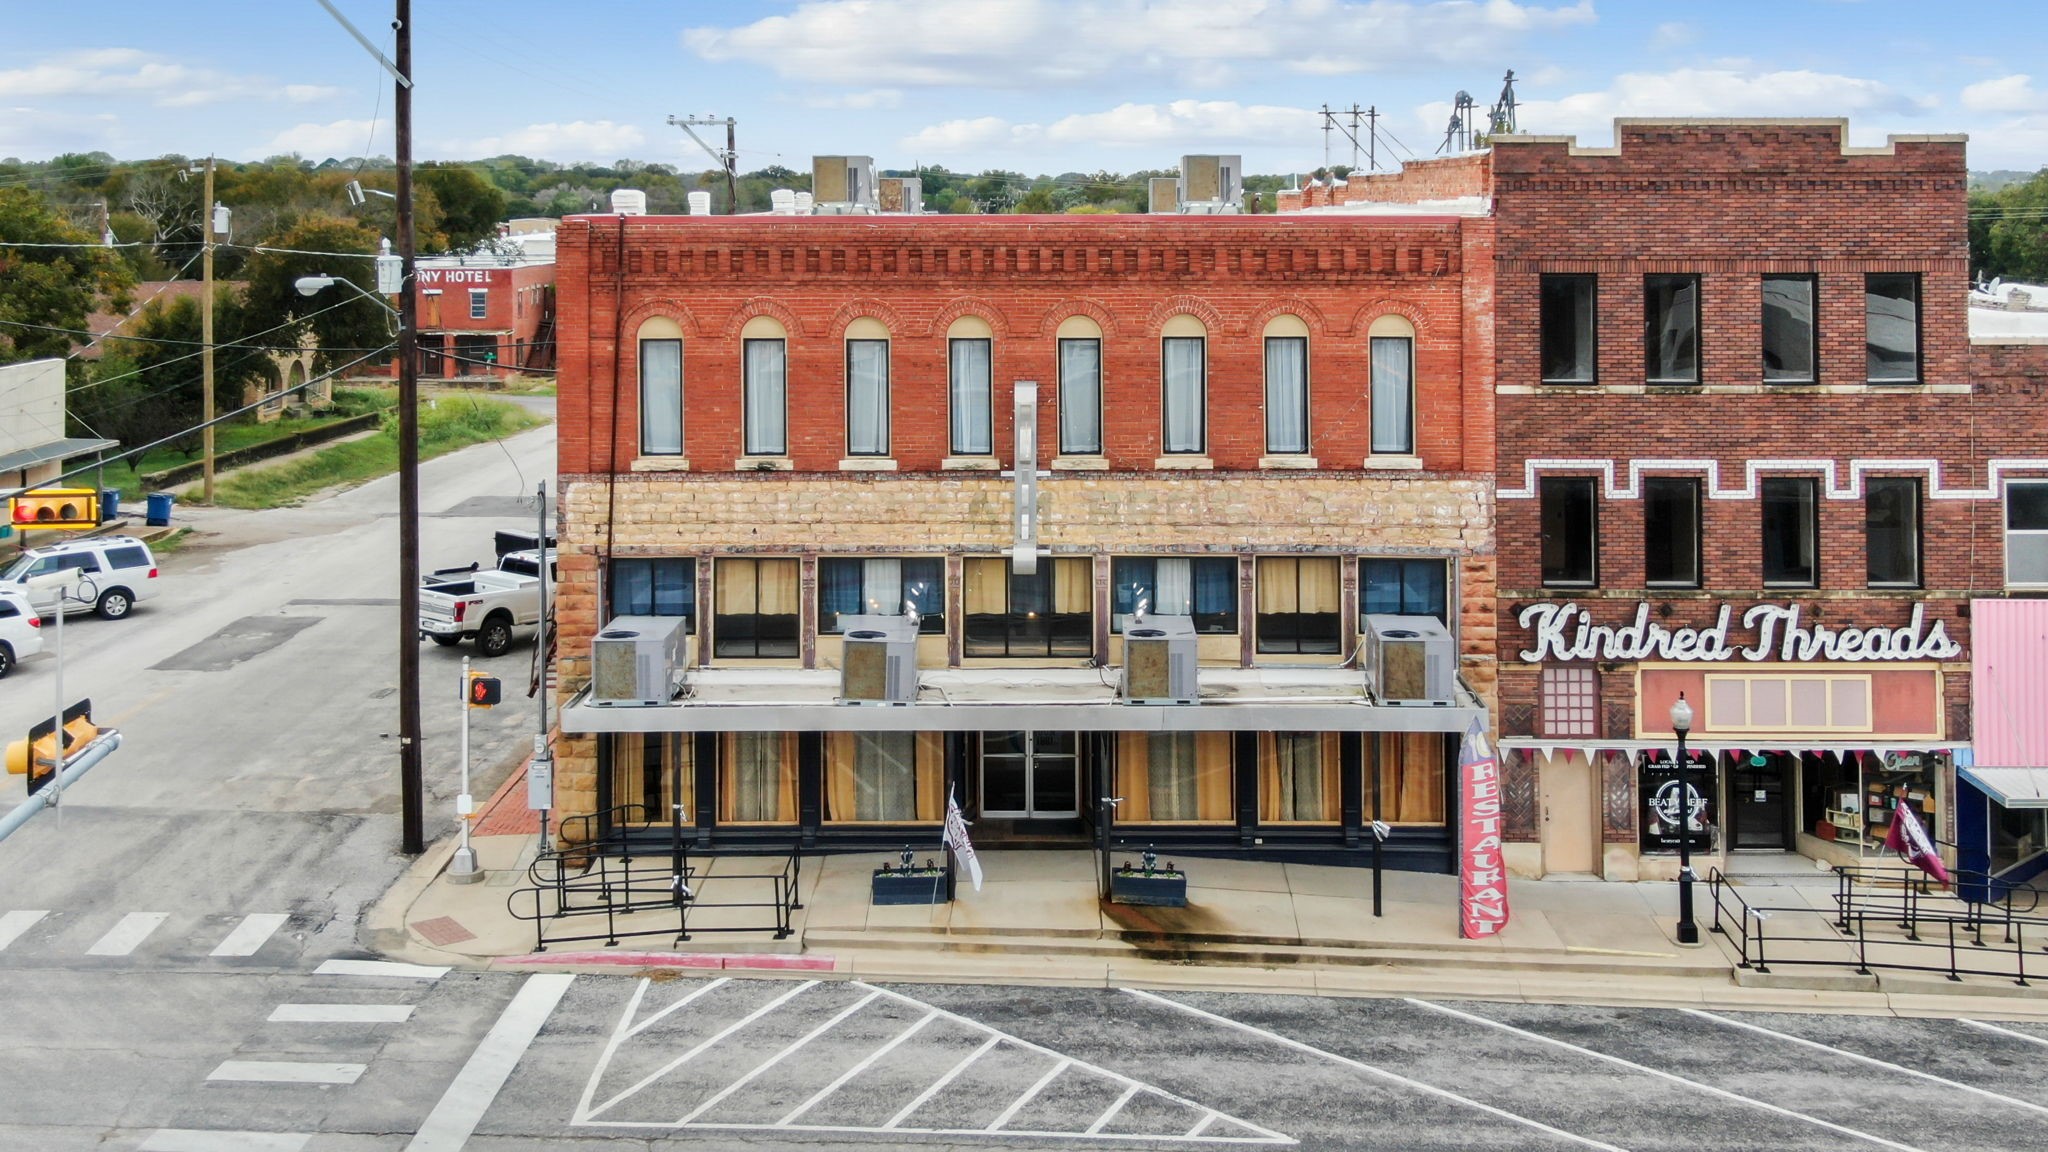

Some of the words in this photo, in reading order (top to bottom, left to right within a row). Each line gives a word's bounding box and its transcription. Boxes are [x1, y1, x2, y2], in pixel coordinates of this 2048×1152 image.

[446, 271, 492, 283] HOTEL
[1518, 601, 1732, 662] Kindred
[1742, 601, 1961, 662] Threads
[1469, 762, 1504, 934] RESTAURANT
